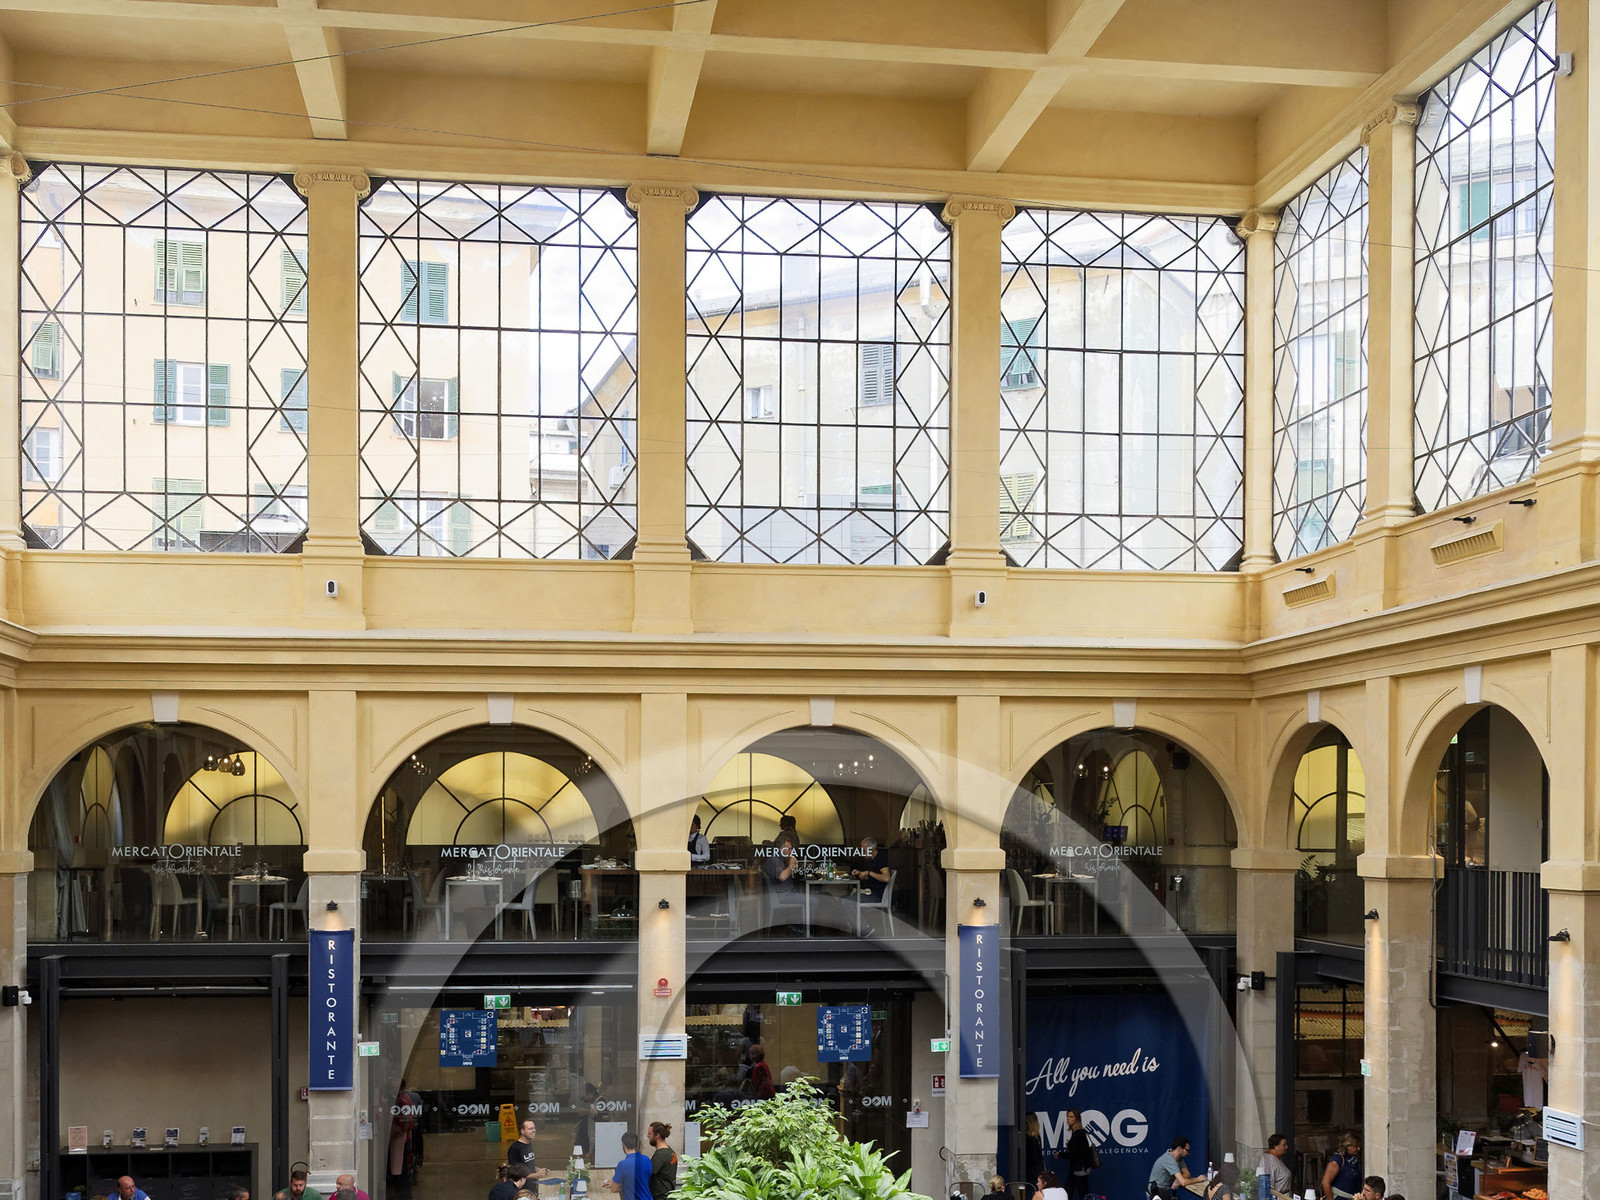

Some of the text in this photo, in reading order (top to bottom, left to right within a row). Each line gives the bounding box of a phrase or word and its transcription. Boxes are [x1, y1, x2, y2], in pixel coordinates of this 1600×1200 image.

[111, 843, 242, 859] MERCATORIENTALE
[754, 844, 873, 859] MERCATORIENTALE
[326, 939, 337, 1080] RISTORANTE
[974, 934, 985, 1068] RISTORANTE
[1026, 1048, 1160, 1097] All you need is
[1035, 1108, 1149, 1149] MOG
